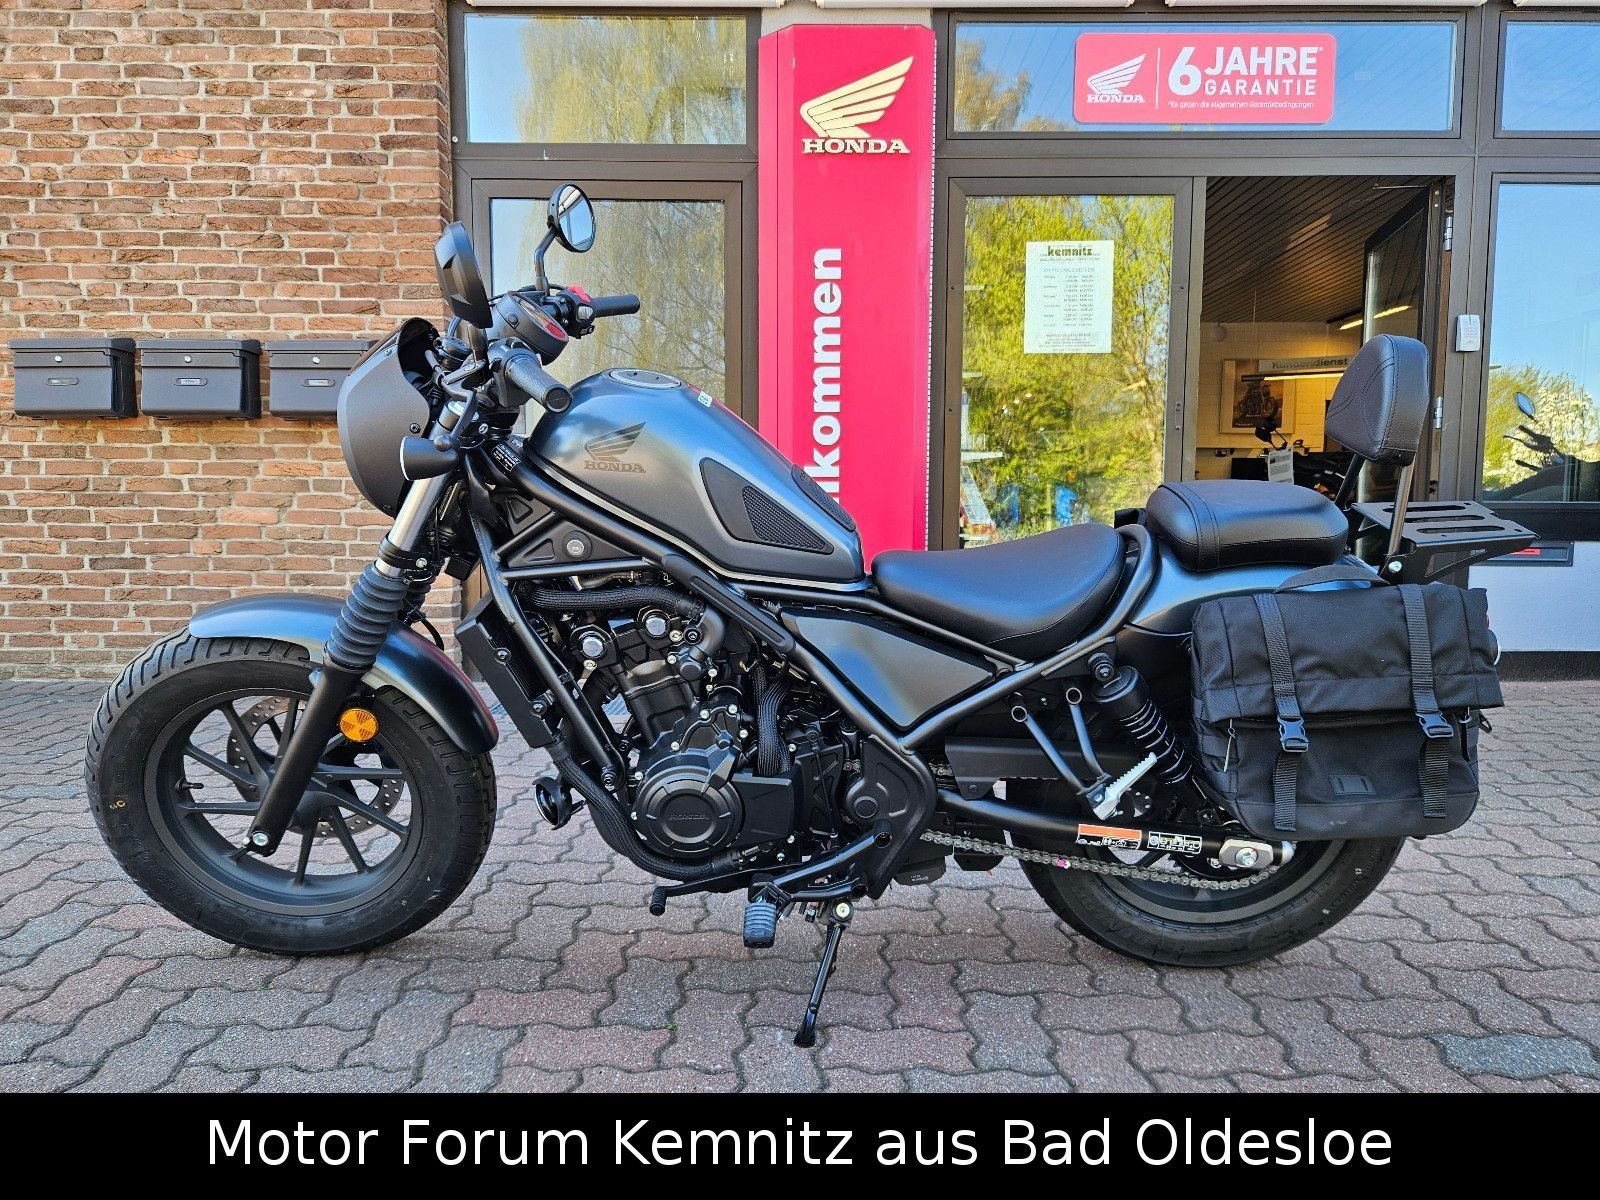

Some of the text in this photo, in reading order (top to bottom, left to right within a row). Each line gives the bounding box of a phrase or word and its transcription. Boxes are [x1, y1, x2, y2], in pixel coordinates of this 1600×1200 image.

[1168, 46, 1202, 96] 6
[1204, 79, 1317, 96] GARANTIE
[1086, 94, 1146, 104] HONDA
[802, 138, 911, 154] HONDA
[1047, 244, 1093, 257] kemnitz
[803, 247, 842, 504] lkommen
[583, 460, 647, 474] HONDA
